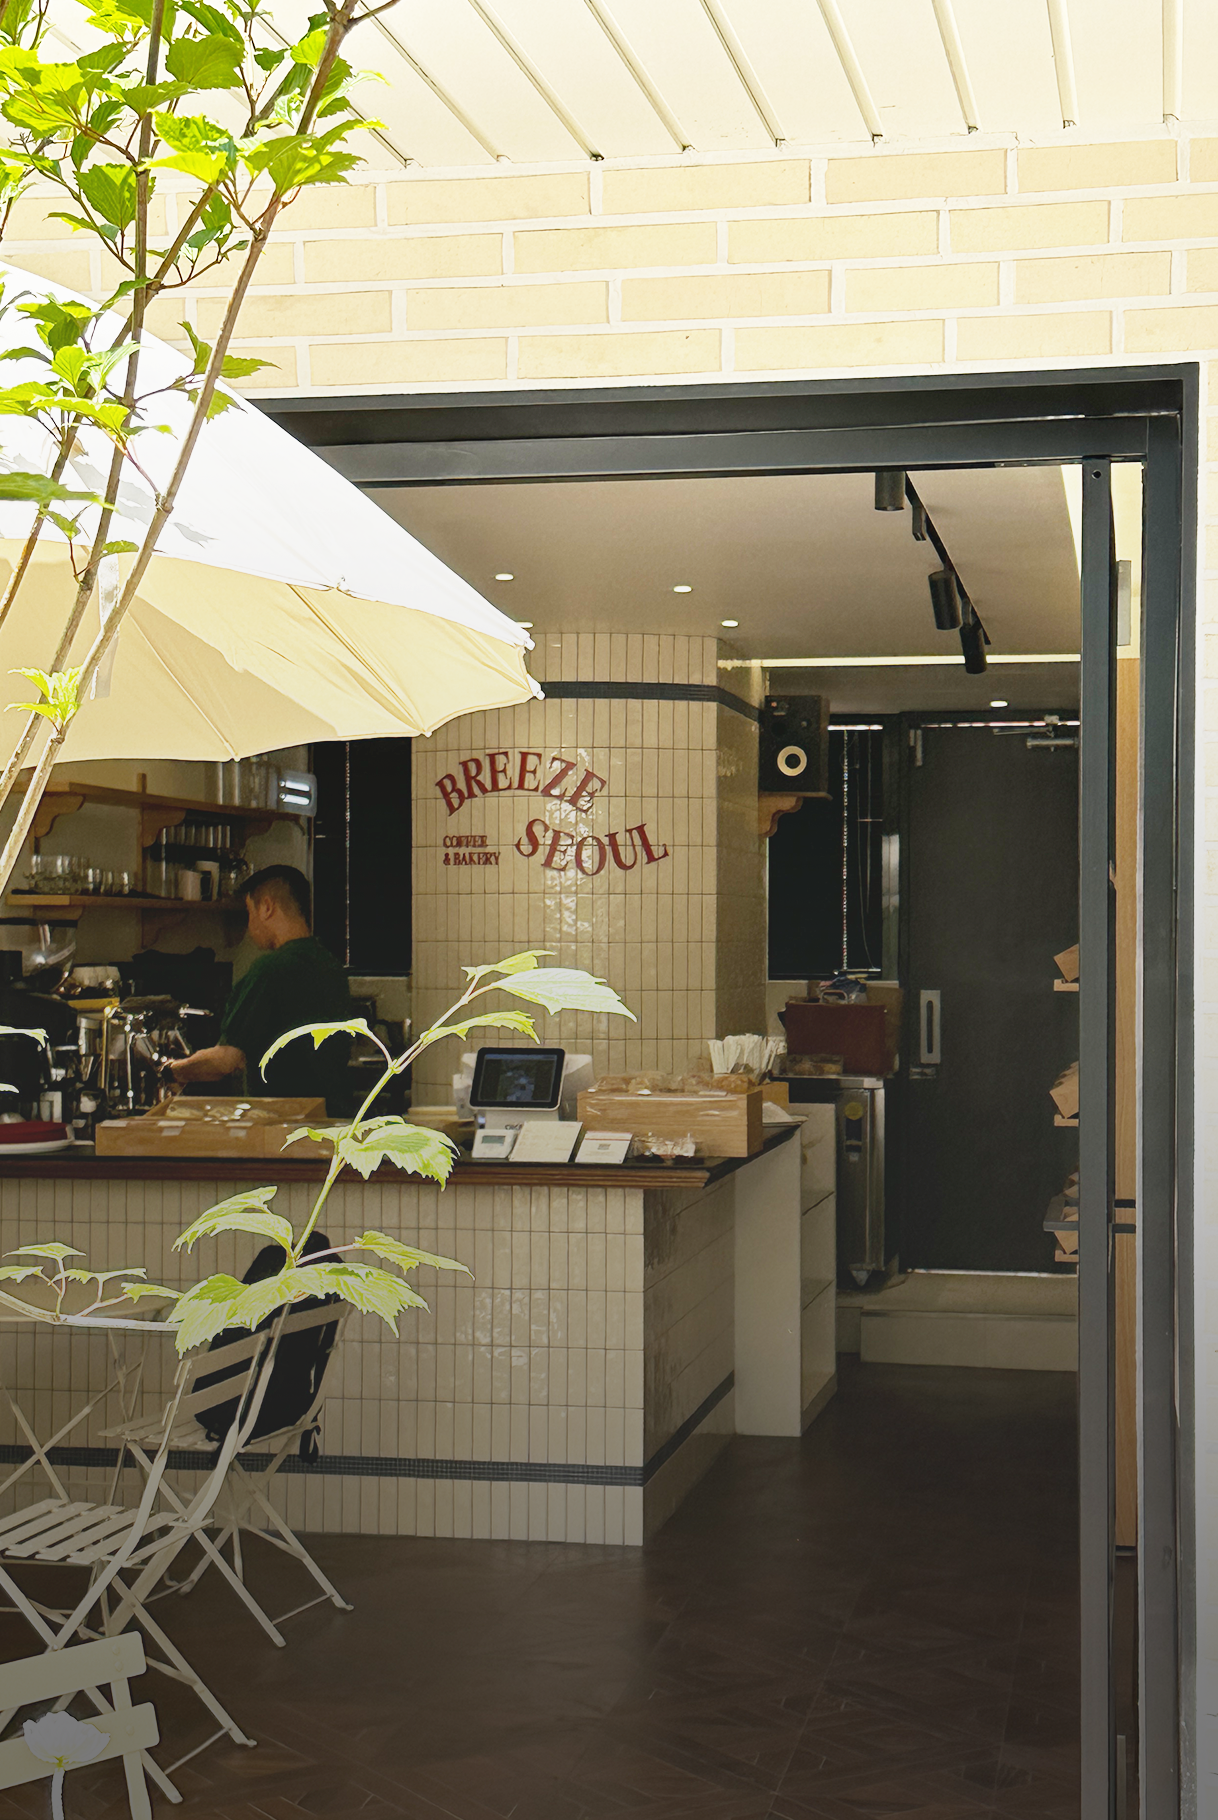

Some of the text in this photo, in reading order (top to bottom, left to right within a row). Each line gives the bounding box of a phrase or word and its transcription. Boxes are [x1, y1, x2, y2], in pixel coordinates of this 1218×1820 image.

[435, 751, 607, 816] BREEZE
[443, 835, 488, 848] COFFEE
[443, 852, 501, 866] & BAKERY
[515, 818, 670, 876] SEOUL
